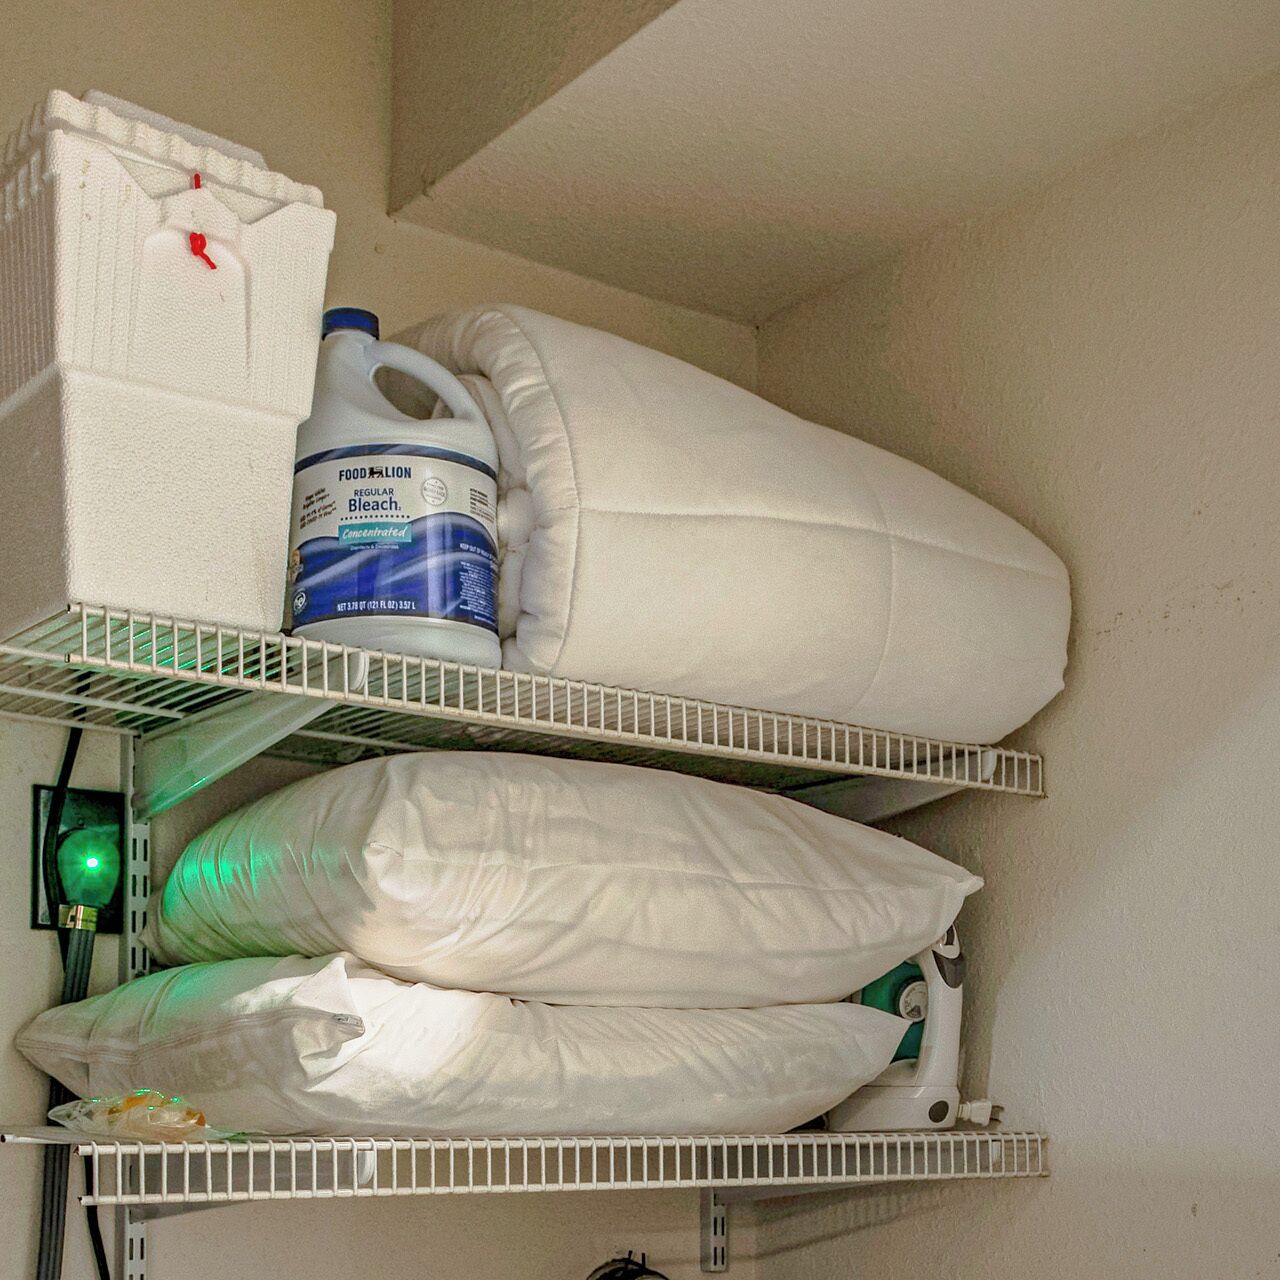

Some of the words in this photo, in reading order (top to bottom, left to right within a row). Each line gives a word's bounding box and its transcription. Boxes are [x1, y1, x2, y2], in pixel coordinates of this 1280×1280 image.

[339, 468, 368, 481] FOOD
[383, 467, 412, 479] LION
[354, 488, 394, 497] REGULAR
[348, 496, 398, 512] Bleach
[342, 526, 407, 540] Concentrated
